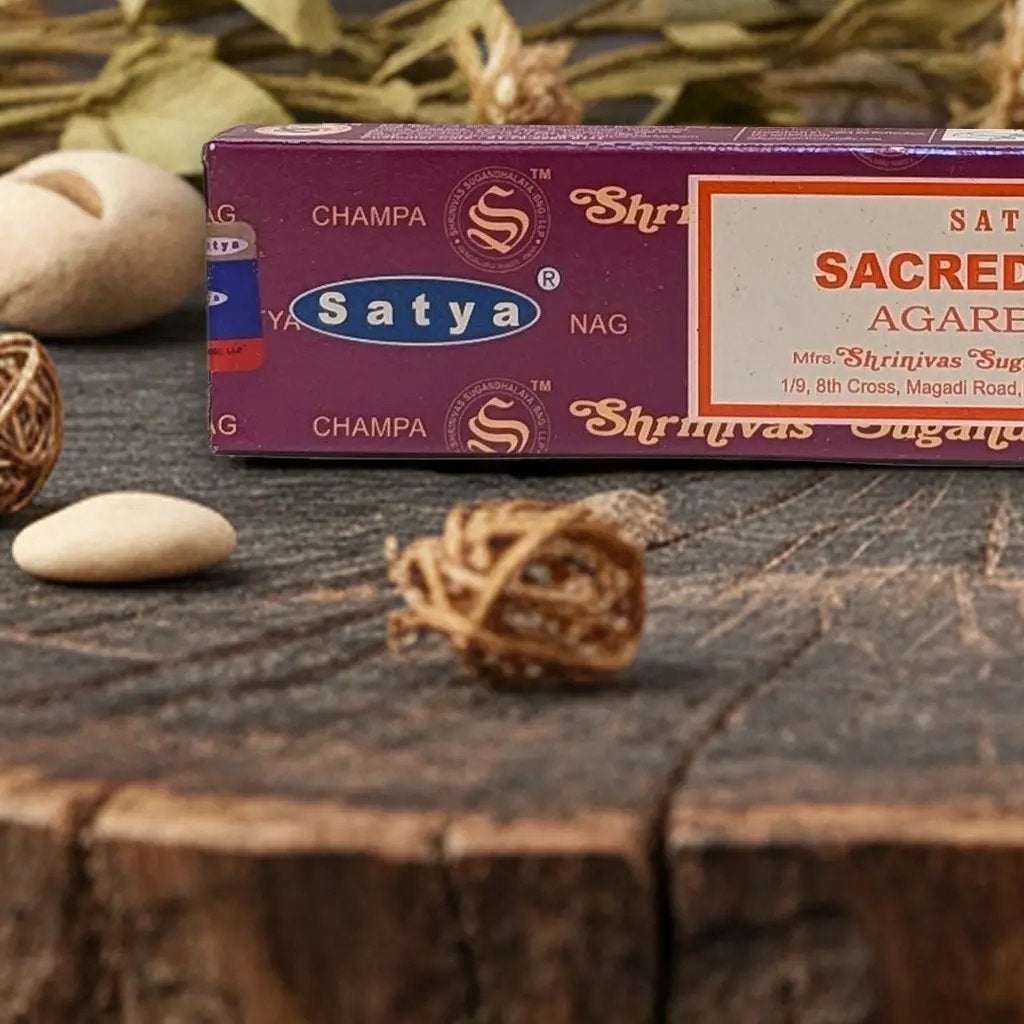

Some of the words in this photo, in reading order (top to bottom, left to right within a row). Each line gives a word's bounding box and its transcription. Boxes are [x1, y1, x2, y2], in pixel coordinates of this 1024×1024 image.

[311, 205, 427, 227] CHAMPA
[260, 309, 301, 331] YA
[317, 291, 521, 336] Satya
[570, 313, 628, 335] NAG
[792, 350, 837, 365] Mfrs.
[836, 346, 962, 372] Shrinivas
[780, 378, 812, 396] 1/9,
[815, 378, 842, 394] 8th
[847, 378, 900, 397] Cross,
[906, 378, 968, 398] Magadi
[312, 416, 428, 437] CHAMPA
